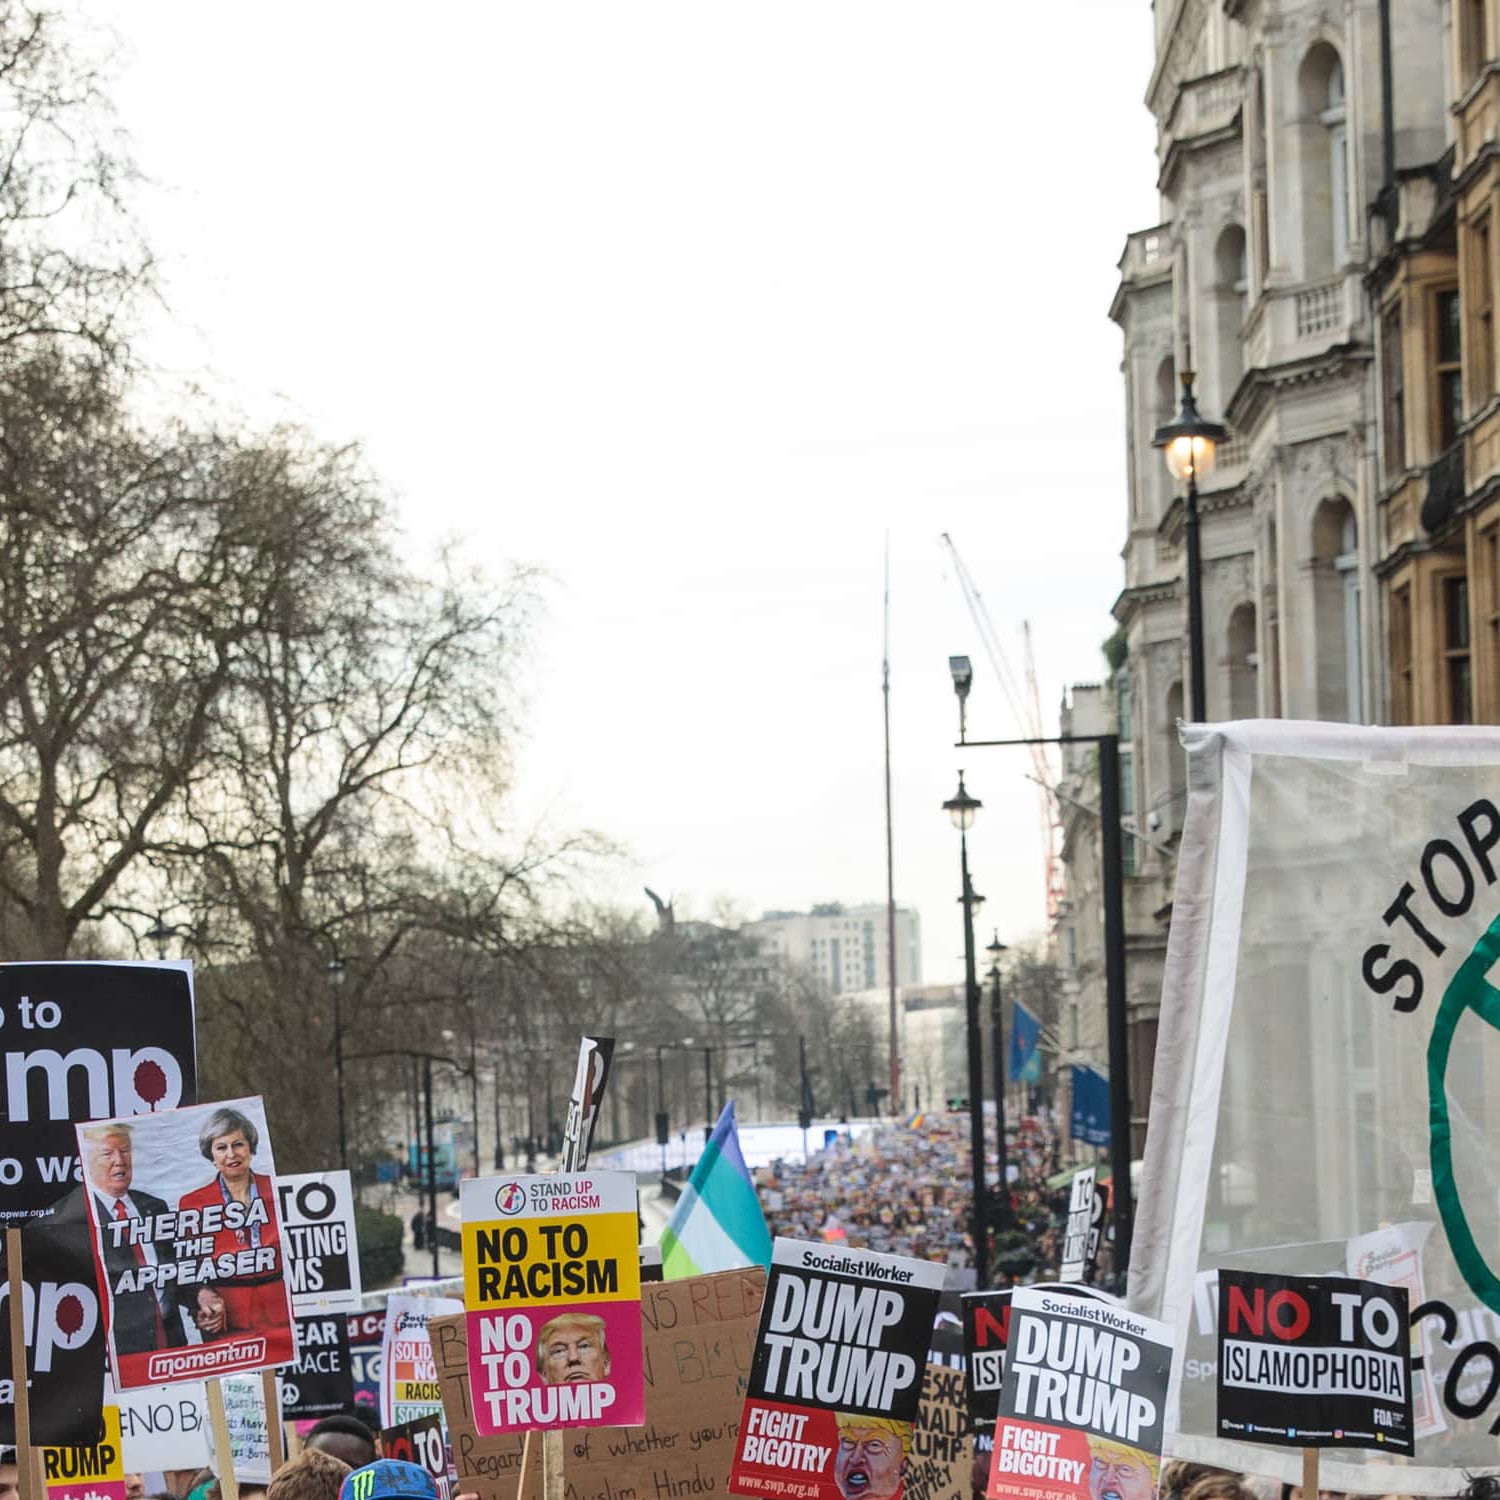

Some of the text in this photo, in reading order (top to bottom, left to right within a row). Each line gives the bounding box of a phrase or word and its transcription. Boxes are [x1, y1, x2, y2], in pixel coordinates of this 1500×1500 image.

[19, 996, 62, 1030] to
[530, 1181, 593, 1197] STAND UP
[531, 1195, 601, 1212] TO RACISM
[107, 1197, 269, 1249] THERESA
[172, 1236, 215, 1259] THE
[476, 1224, 589, 1265] NO TO
[113, 1247, 276, 1295] APPEASER
[478, 1258, 619, 1301] RACISM
[769, 1273, 905, 1348] DUMP
[1228, 1286, 1400, 1349] NO TO
[479, 1314, 533, 1354] NO
[1015, 1315, 1141, 1386] DUMP
[155, 1342, 260, 1377] momentum
[481, 1351, 531, 1390] TO
[764, 1333, 916, 1411] TRUMP
[1225, 1344, 1403, 1398] ISLAMOPHOBIA
[484, 1383, 617, 1428] TRUMP
[1012, 1363, 1157, 1442] TRUMP
[574, 1428, 678, 1459] of whether
[747, 1407, 809, 1441] FIGHT
[1001, 1425, 1060, 1456] FIGHT
[414, 1427, 444, 1473] TO
[742, 1435, 832, 1473] BIGOTRY
[999, 1449, 1086, 1485] BIGOTRY
[655, 1470, 716, 1499] Hindu
[738, 1473, 821, 1499] www.swp.org.uk
